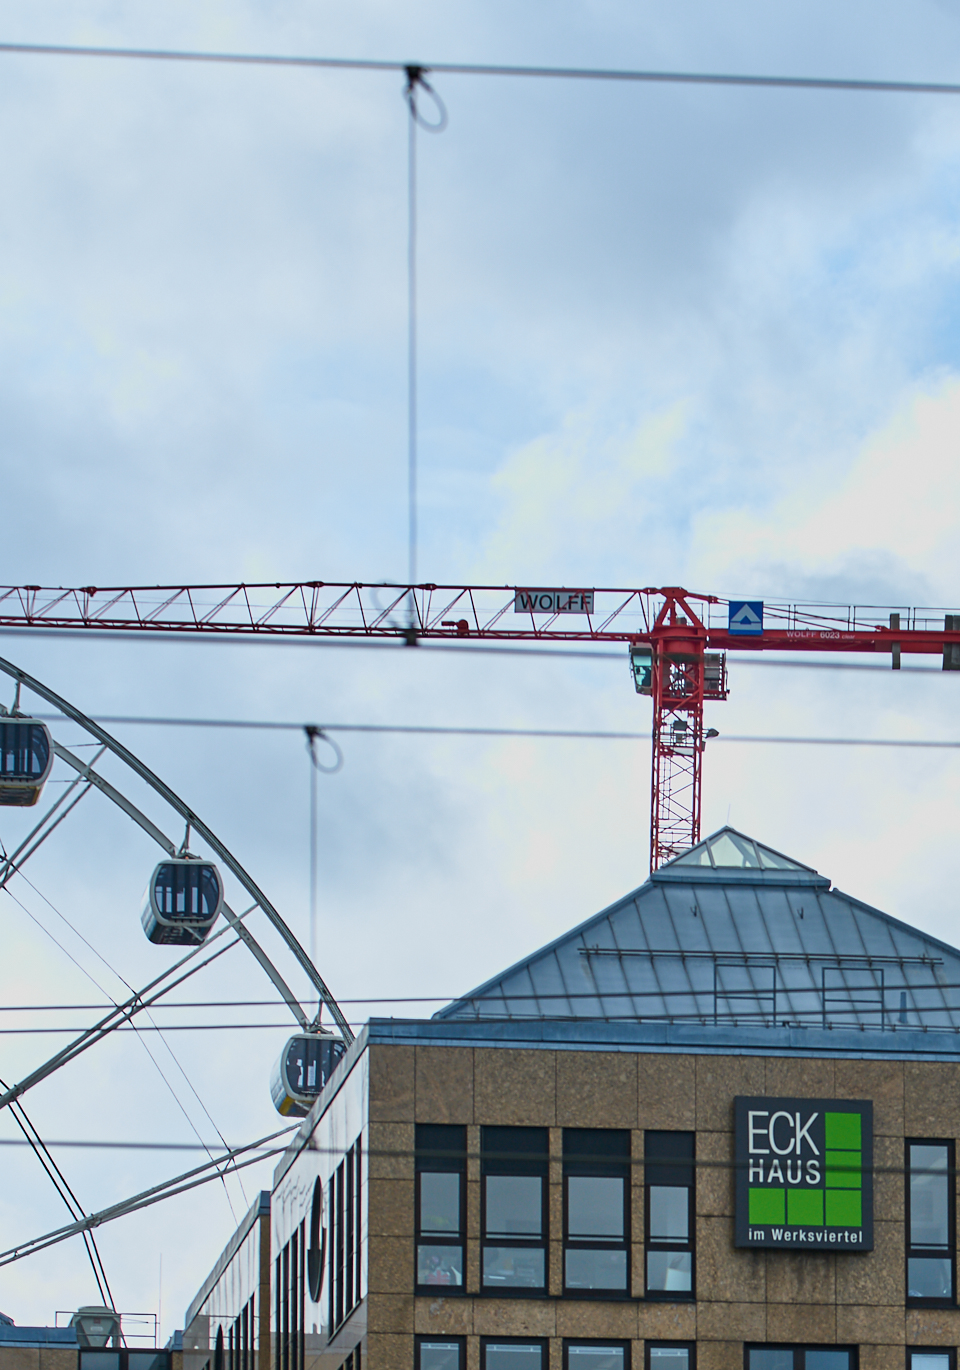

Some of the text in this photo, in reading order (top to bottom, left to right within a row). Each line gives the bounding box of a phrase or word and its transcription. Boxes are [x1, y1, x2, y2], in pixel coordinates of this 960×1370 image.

[520, 594, 592, 610] WOLFF
[786, 630, 817, 638] WOLFF
[820, 631, 840, 639] 6023
[748, 1110, 820, 1156] ECK
[748, 1158, 821, 1184] HAUS
[748, 1228, 863, 1243] im Werksviertel
